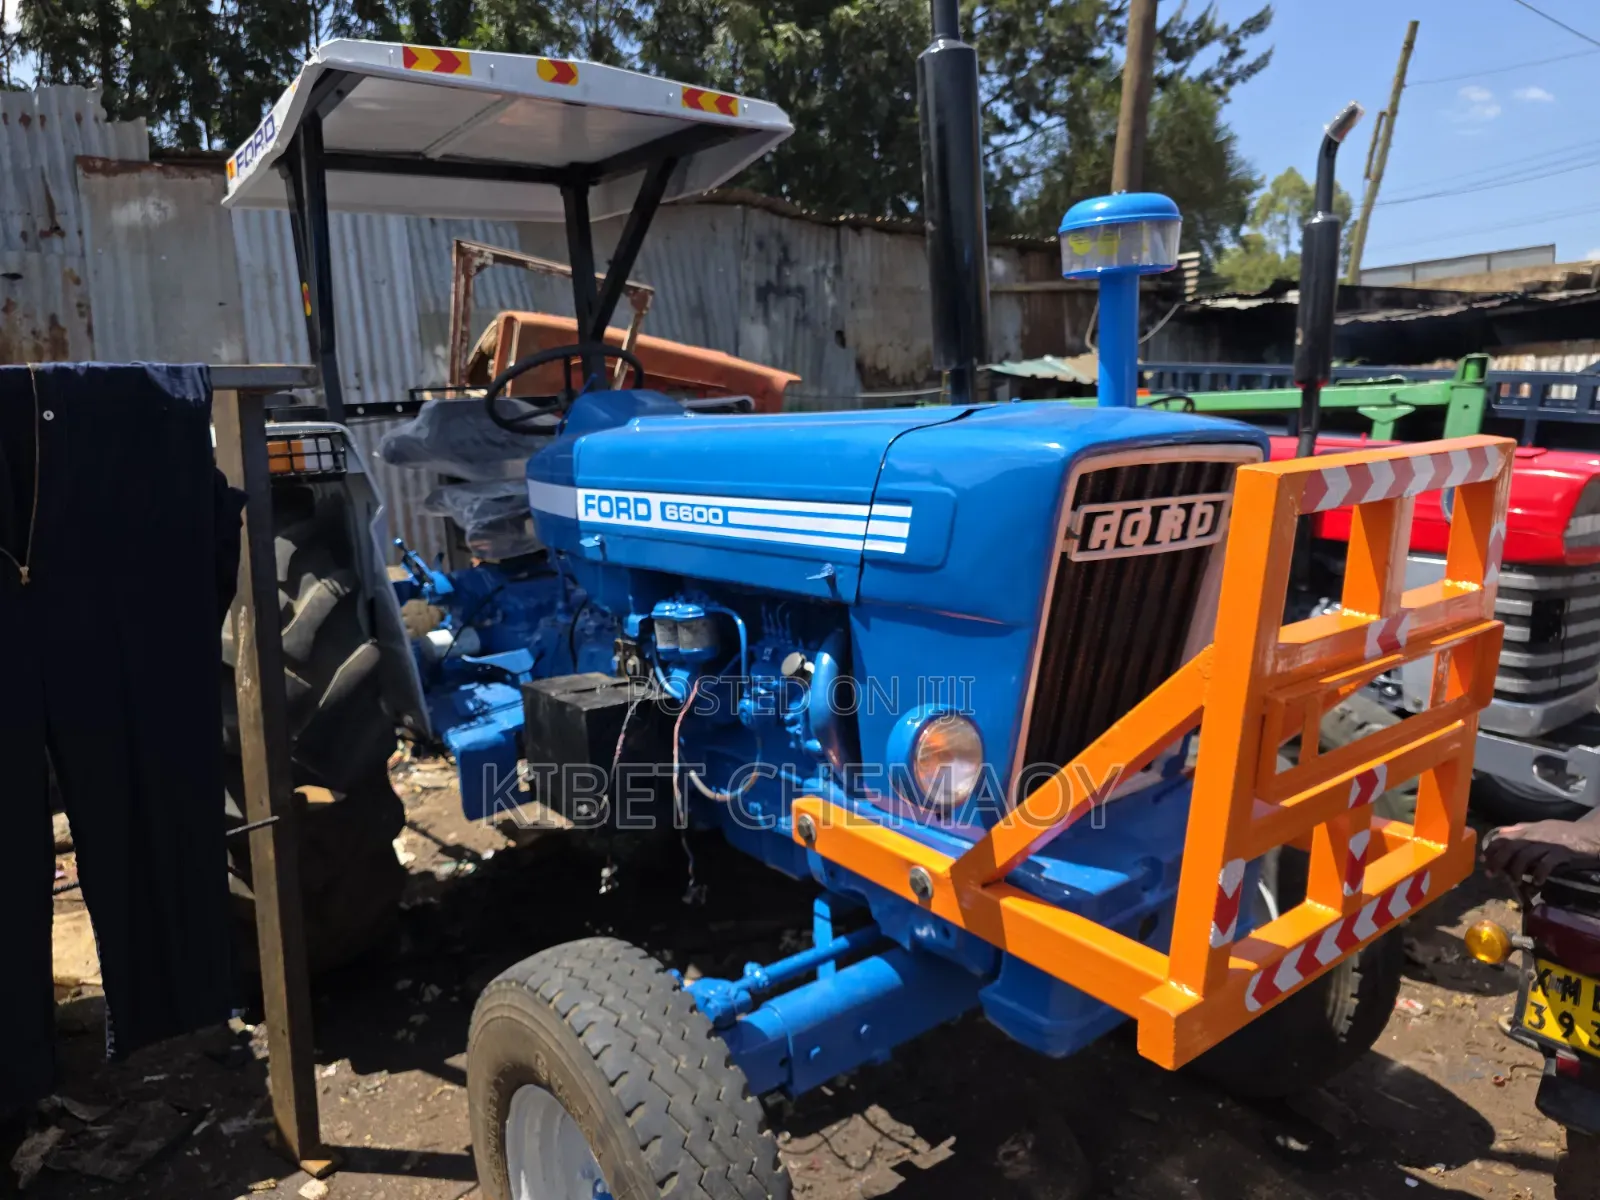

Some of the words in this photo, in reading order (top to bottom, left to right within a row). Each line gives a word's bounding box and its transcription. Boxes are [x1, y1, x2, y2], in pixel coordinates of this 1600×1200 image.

[235, 113, 275, 177] FORD
[584, 494, 652, 522] FORD
[664, 504, 724, 525] 6600
